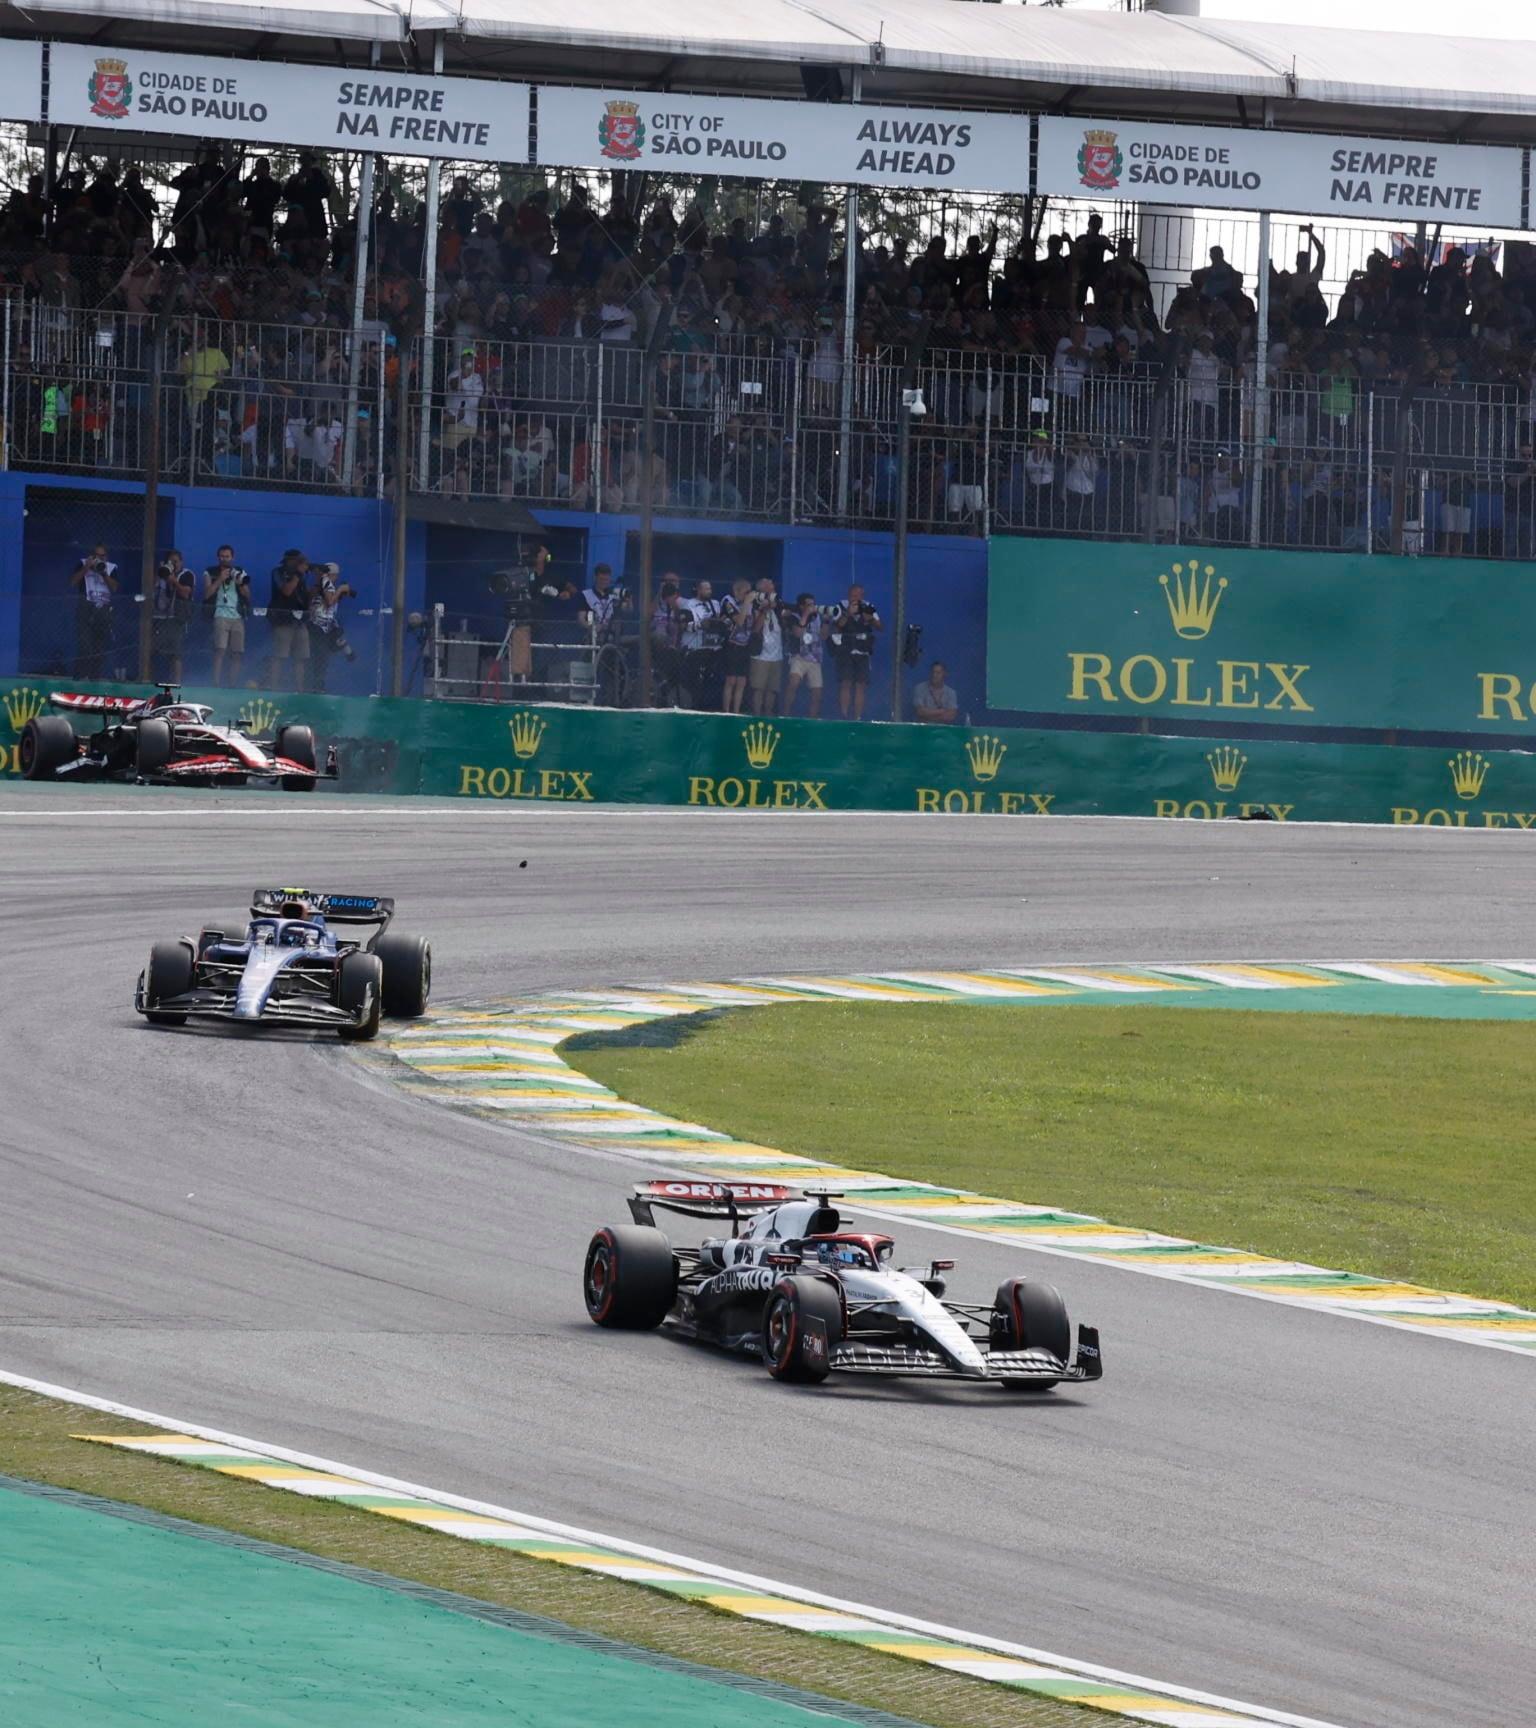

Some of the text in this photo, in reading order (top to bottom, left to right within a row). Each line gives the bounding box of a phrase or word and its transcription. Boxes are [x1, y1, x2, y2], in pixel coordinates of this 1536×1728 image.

[139, 71, 237, 95] CIDADE DE
[337, 81, 445, 113] SEMPRE
[138, 90, 268, 123] SÃO PAULO
[335, 111, 490, 146] NA FRENTE
[651, 113, 724, 133] CITY OF
[856, 119, 972, 148] ALWAYS
[651, 131, 787, 161] SÃO PAULO
[1129, 142, 1230, 165] CIDADE DE
[855, 148, 956, 176] AHEAD
[1128, 160, 1261, 190] SÃO PAULO
[1330, 149, 1438, 179] SEMPRE
[1329, 178, 1482, 211] NA FRENTE
[1067, 653, 1314, 712] ROLEX
[459, 766, 594, 800] ROLEX
[688, 777, 829, 811] ROLEX
[916, 788, 1056, 815] ROLEX
[330, 897, 376, 908] RACING
